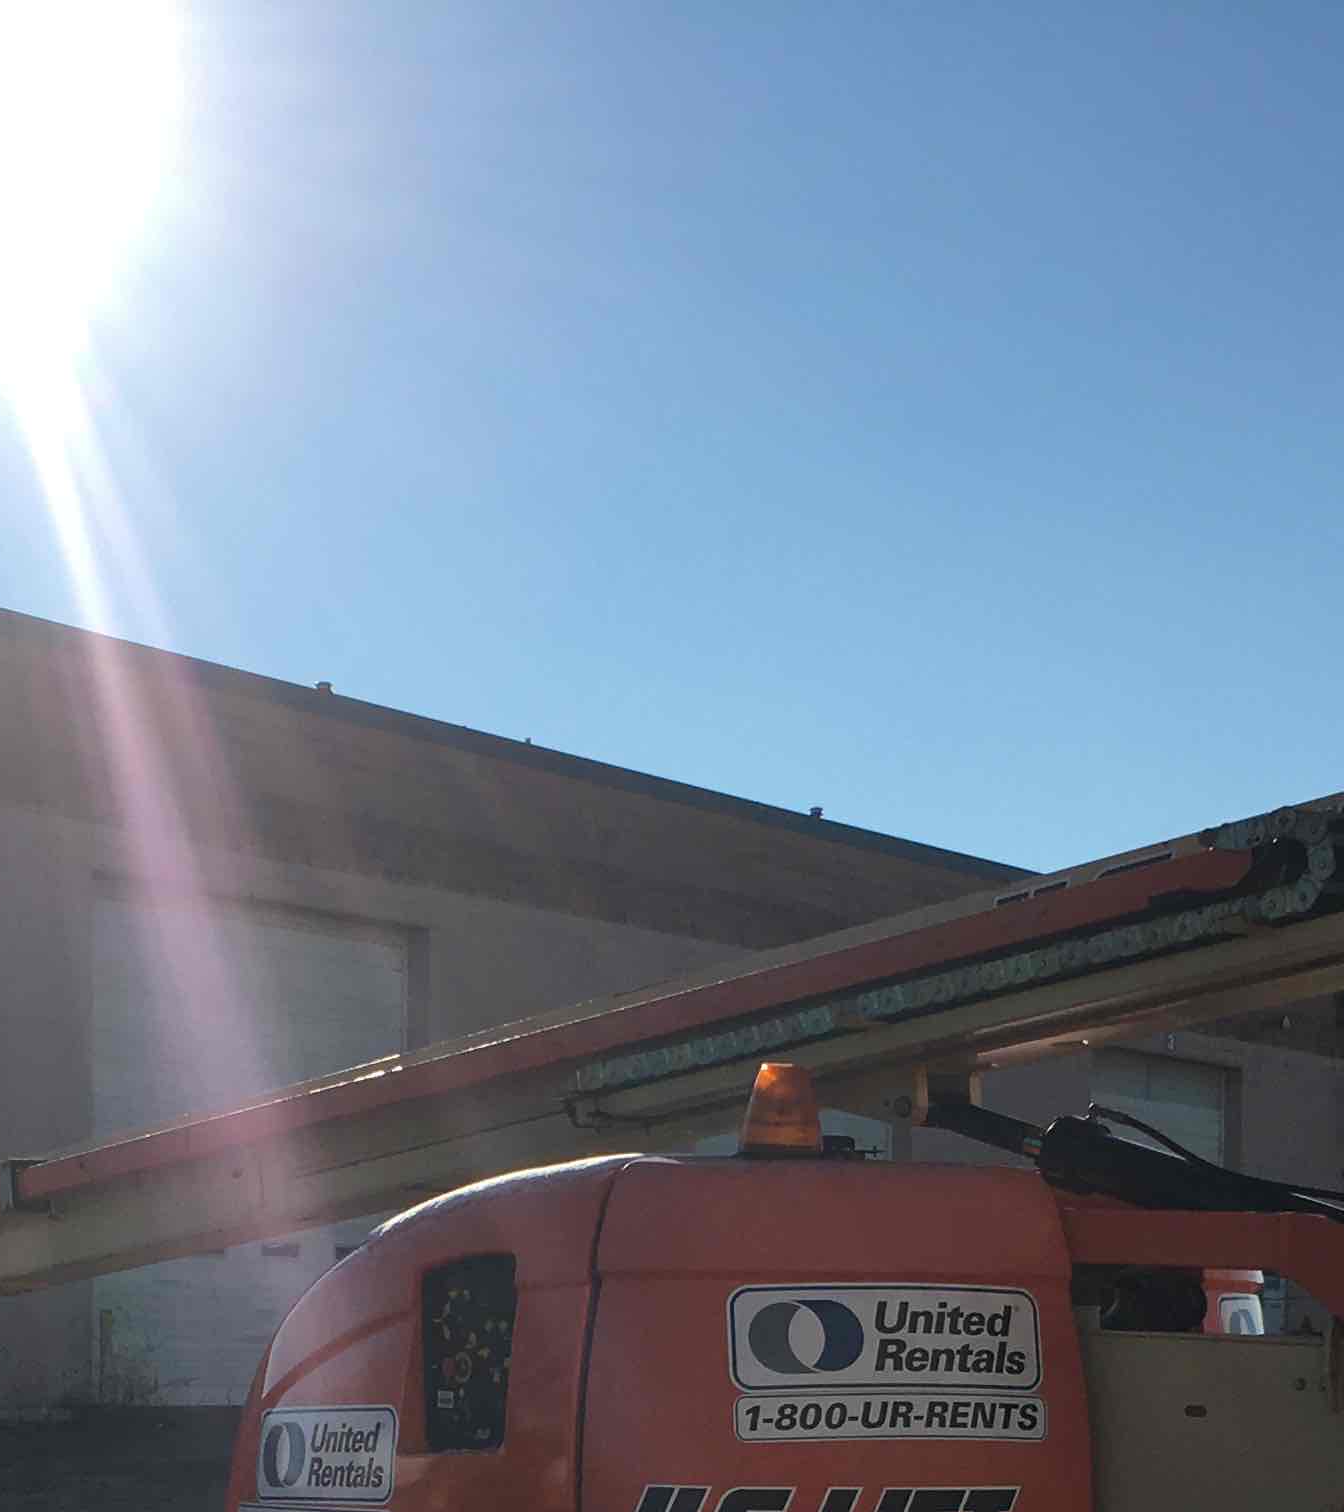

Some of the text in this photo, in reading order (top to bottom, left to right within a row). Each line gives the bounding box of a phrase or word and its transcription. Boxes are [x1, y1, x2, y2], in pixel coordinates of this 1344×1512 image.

[874, 1301, 1012, 1337] United
[874, 1338, 1027, 1375] Rentals
[744, 1401, 1039, 1432] 1-800-UR-RENTS
[310, 1421, 382, 1453] United
[307, 1456, 385, 1489] Rentals
